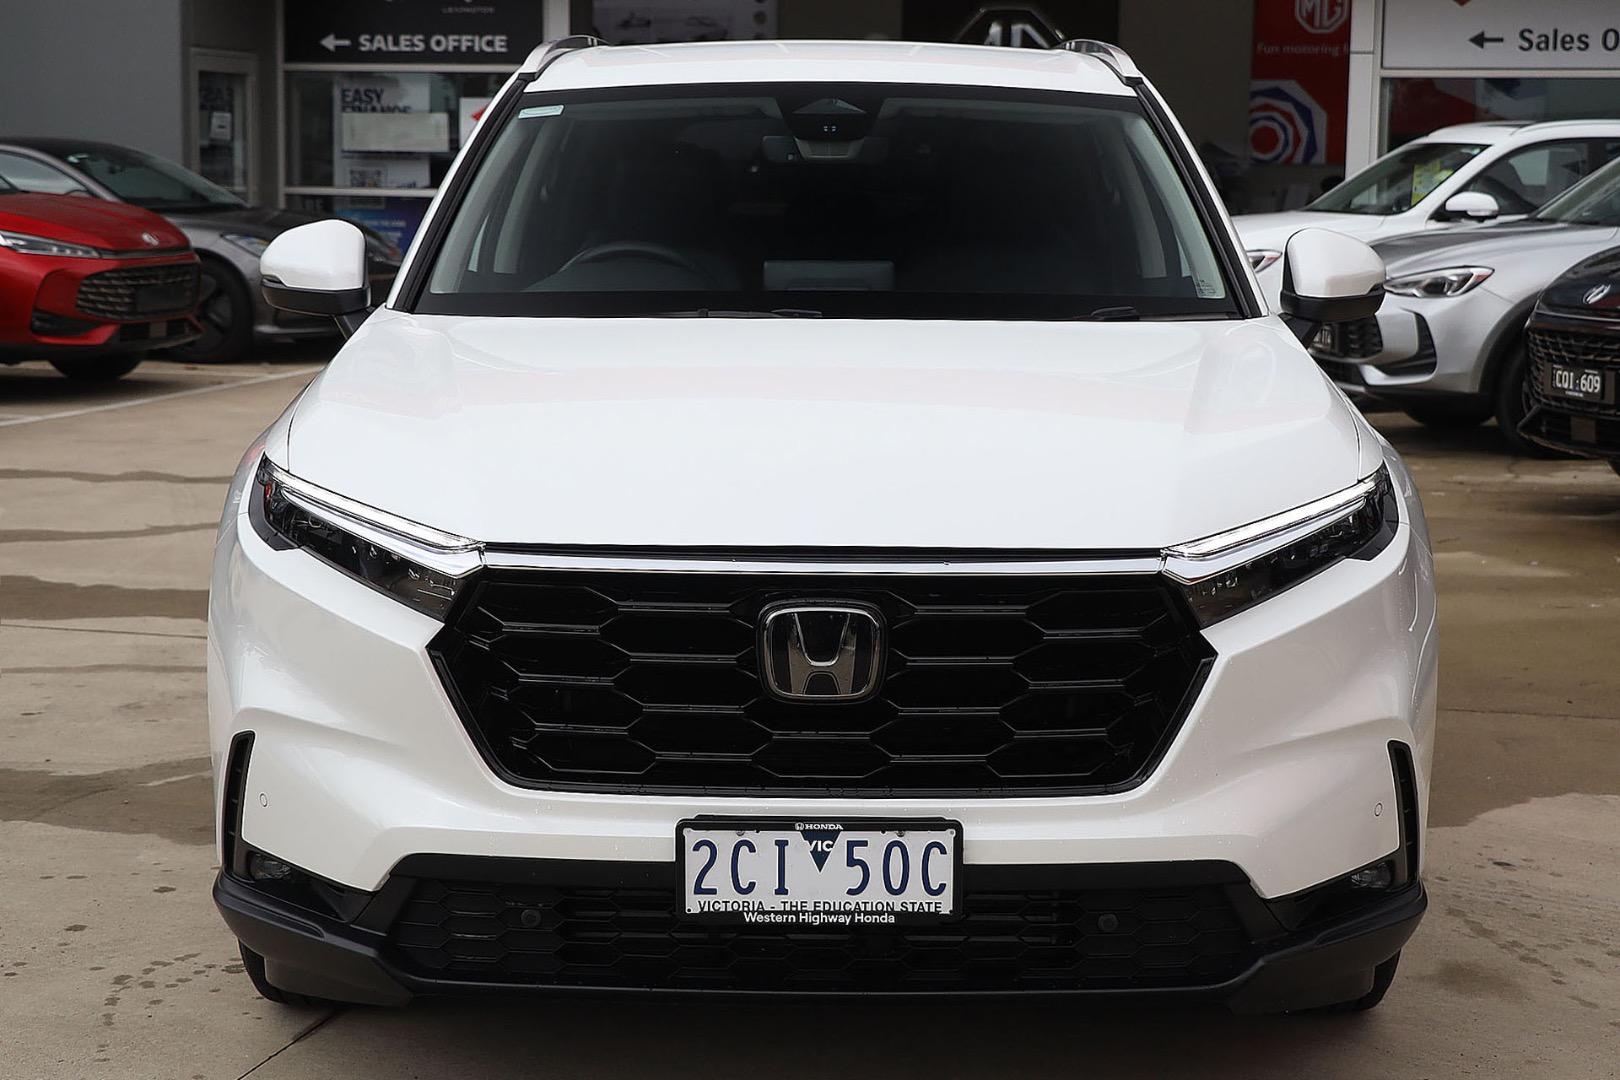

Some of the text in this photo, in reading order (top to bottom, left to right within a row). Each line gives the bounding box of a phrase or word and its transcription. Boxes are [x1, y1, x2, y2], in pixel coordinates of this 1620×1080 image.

[358, 34, 508, 52] SALES OFFICE
[1518, 27, 1590, 52] Sales
[1256, 42, 1279, 54] Fun
[1281, 42, 1339, 57] motoring
[341, 87, 384, 104] EASY
[804, 823, 844, 831] HONDA
[808, 840, 834, 853] VIC
[697, 900, 765, 912] VICTORIA
[781, 900, 807, 912] THE
[812, 900, 895, 912] EDUCATION
[900, 900, 943, 912] STATE
[743, 911, 896, 926] Western Highway Honda
